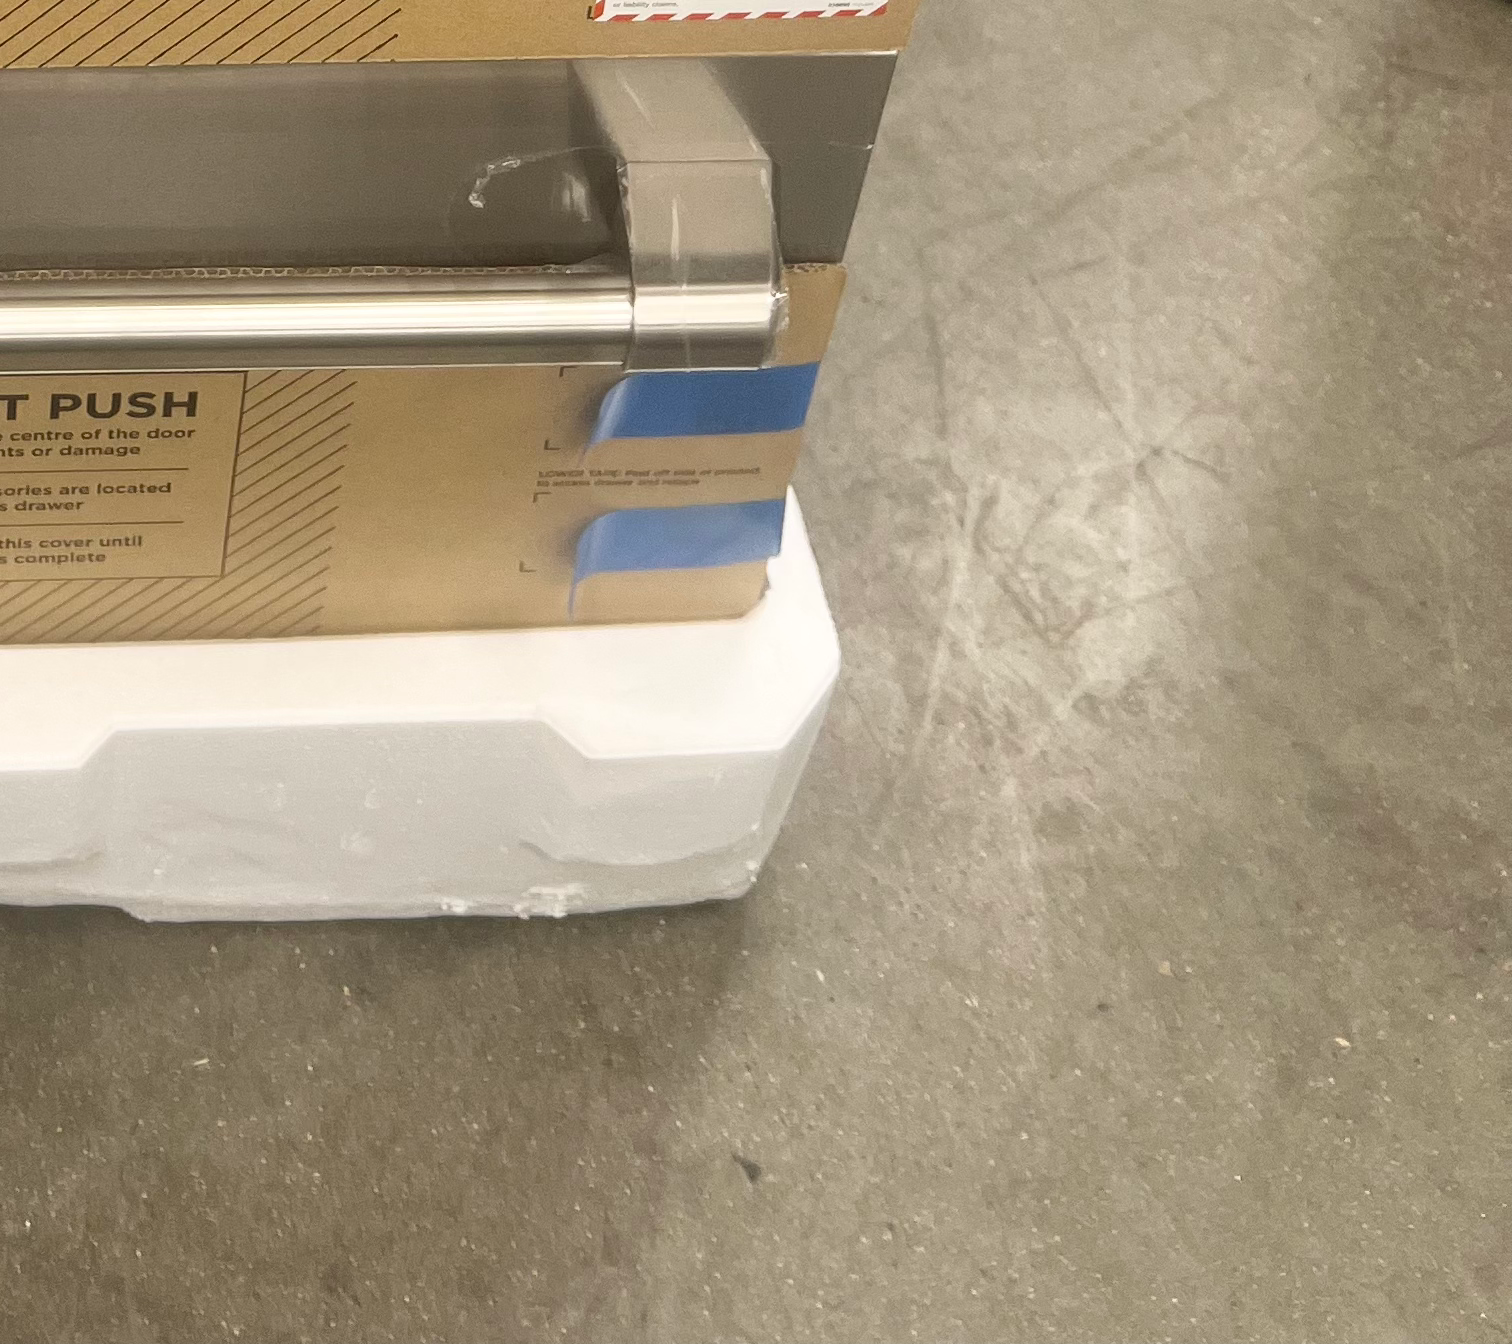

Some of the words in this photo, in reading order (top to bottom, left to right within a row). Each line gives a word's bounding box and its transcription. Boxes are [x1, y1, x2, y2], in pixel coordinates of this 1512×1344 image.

[50, 391, 198, 420] PUSH
[10, 431, 74, 441] centre
[81, 429, 102, 440] of
[108, 428, 140, 439] the
[147, 428, 196, 439] door
[31, 448, 53, 457] or
[59, 445, 140, 457] damage
[59, 486, 90, 495] are
[97, 482, 172, 495] located
[14, 500, 84, 511] drawer
[39, 539, 94, 548] cover
[99, 535, 142, 547] until
[14, 552, 106, 565] complete
